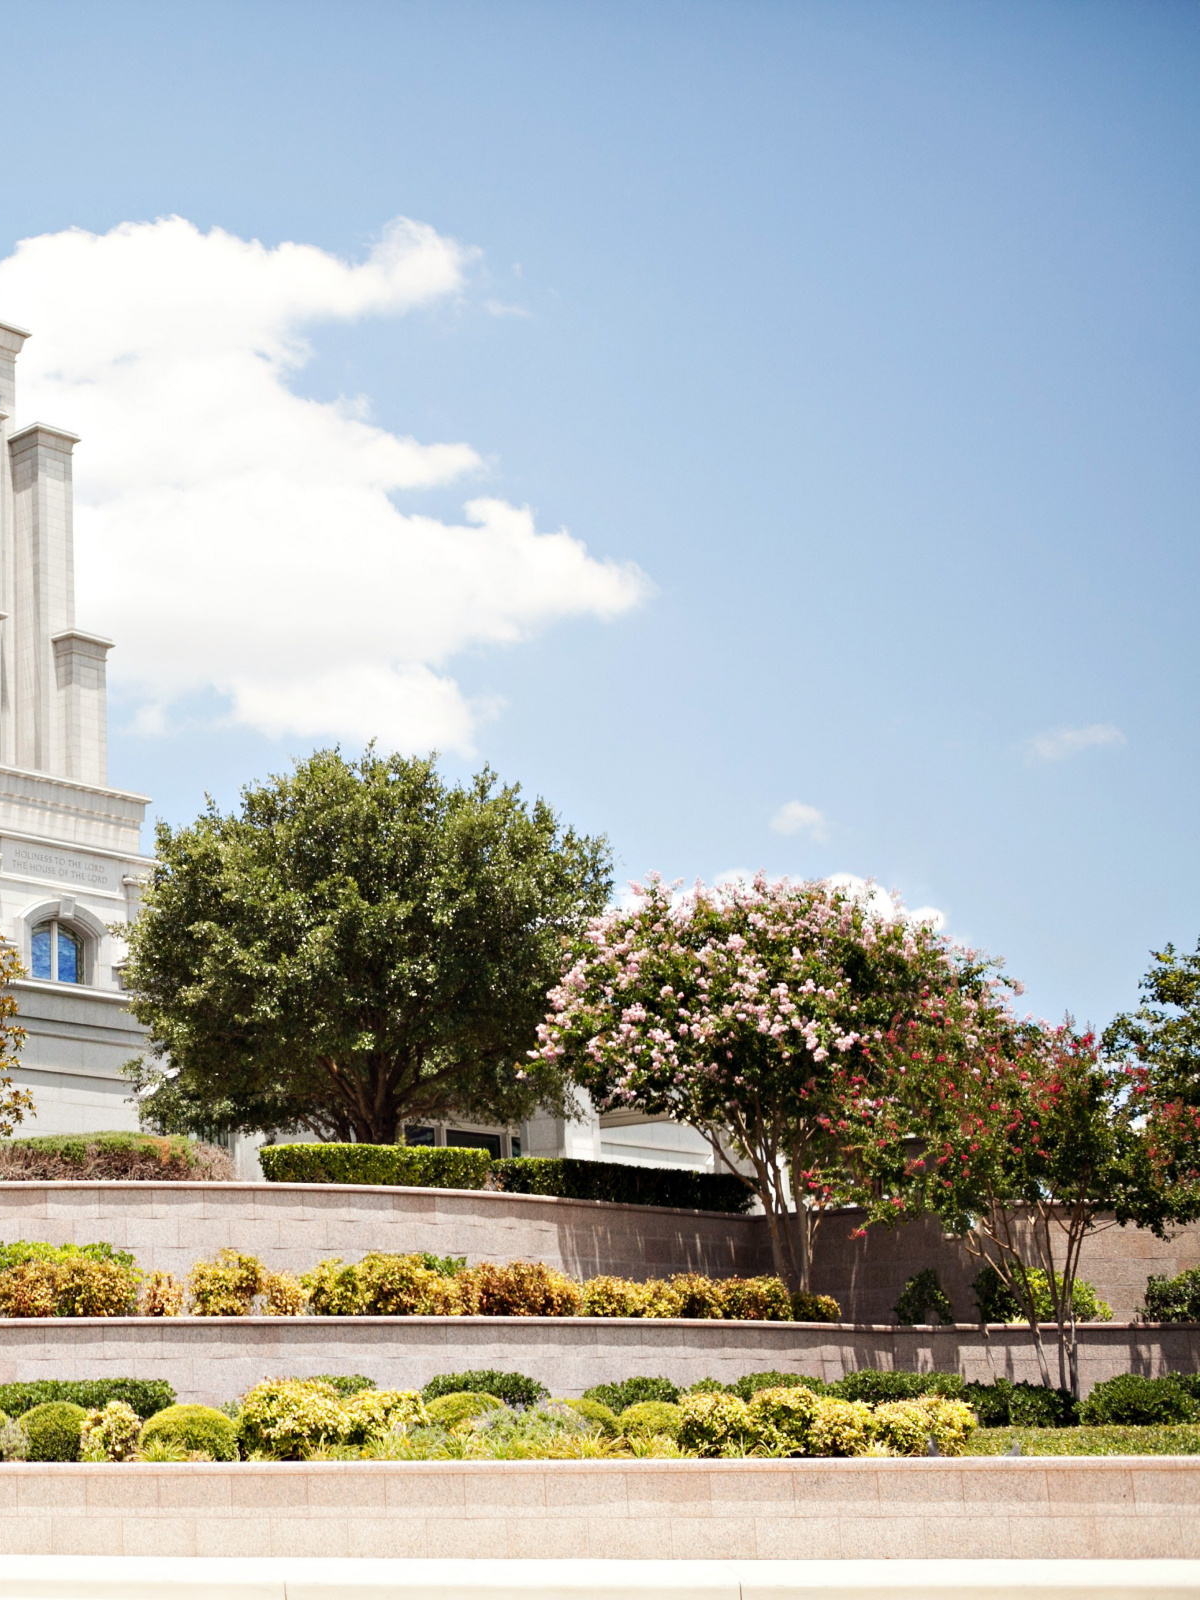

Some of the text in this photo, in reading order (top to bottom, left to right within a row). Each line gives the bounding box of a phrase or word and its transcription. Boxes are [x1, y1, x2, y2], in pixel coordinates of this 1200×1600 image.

[12, 859, 108, 884] THE HOUSE OF THE LORD
[14, 849, 105, 873] HOLINESS TO THE LORD
